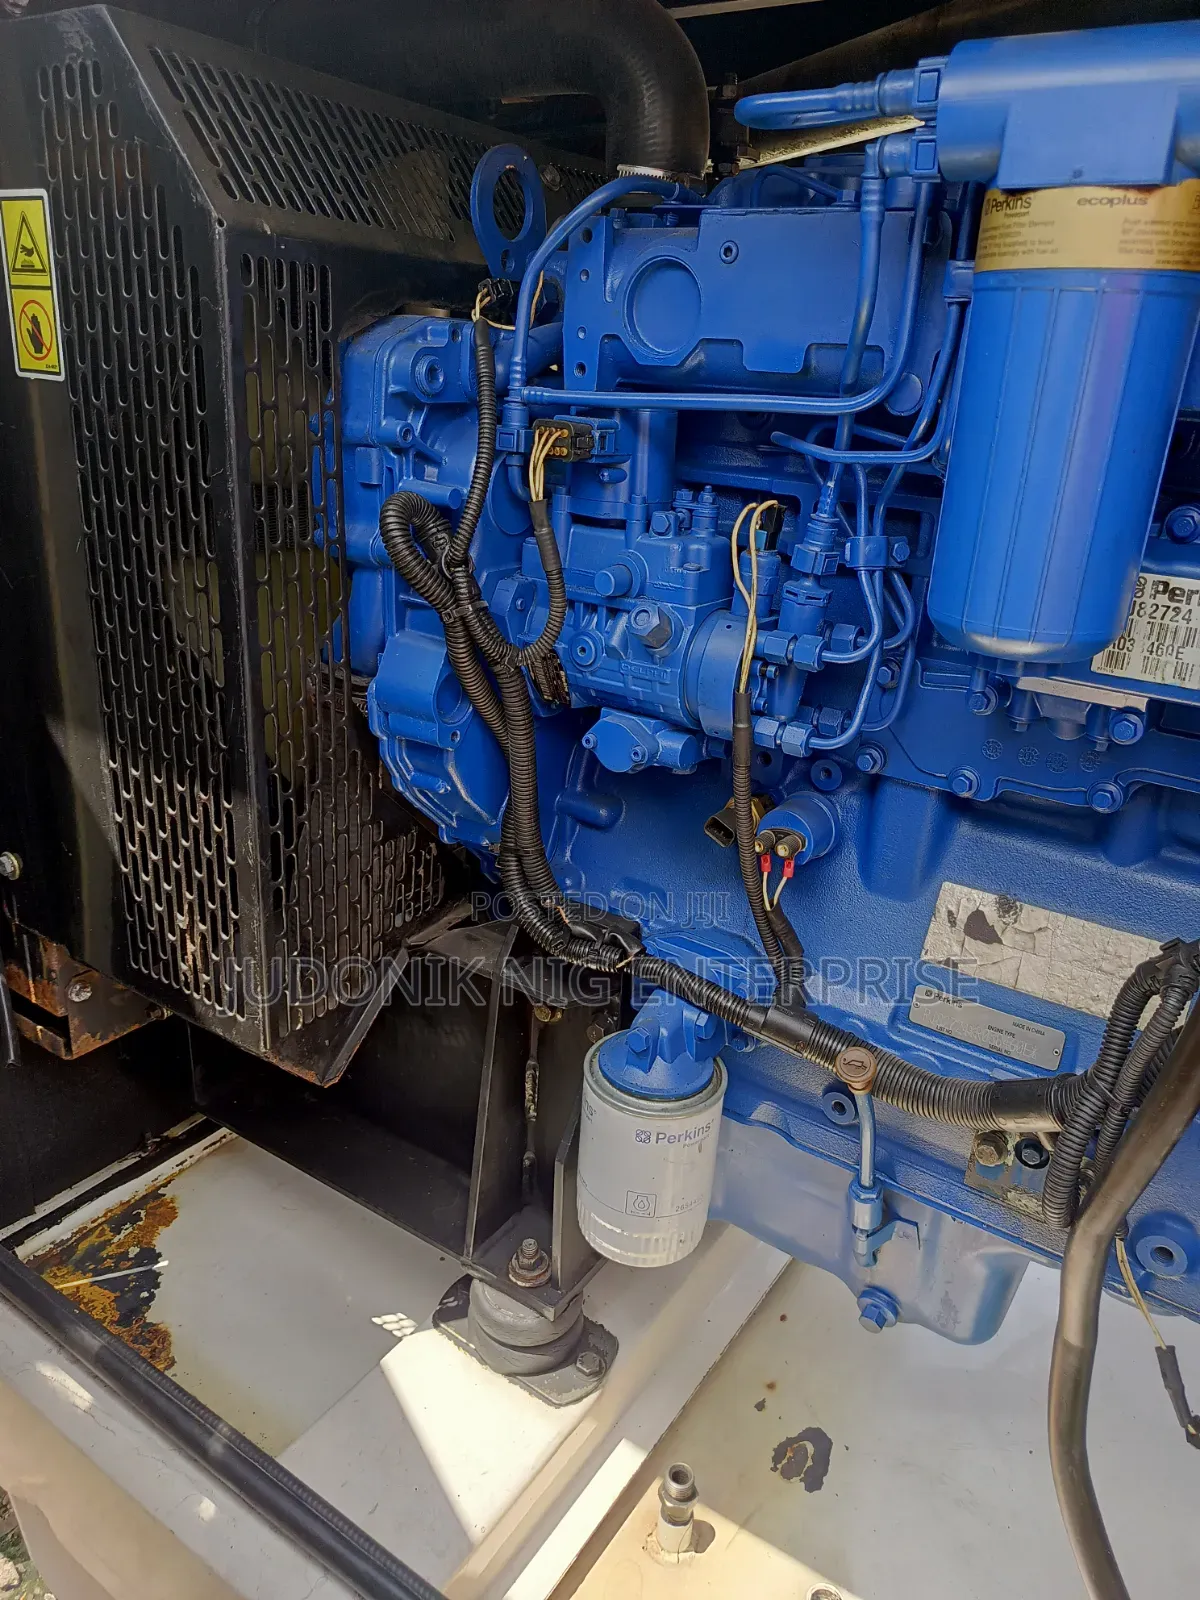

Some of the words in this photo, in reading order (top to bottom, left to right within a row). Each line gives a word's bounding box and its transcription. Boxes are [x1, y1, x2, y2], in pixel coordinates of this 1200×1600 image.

[991, 195, 1032, 213] Perkins
[1077, 194, 1147, 208] ecoplus
[933, 992, 962, 1009] Perkins
[655, 1122, 711, 1145] Perkins
